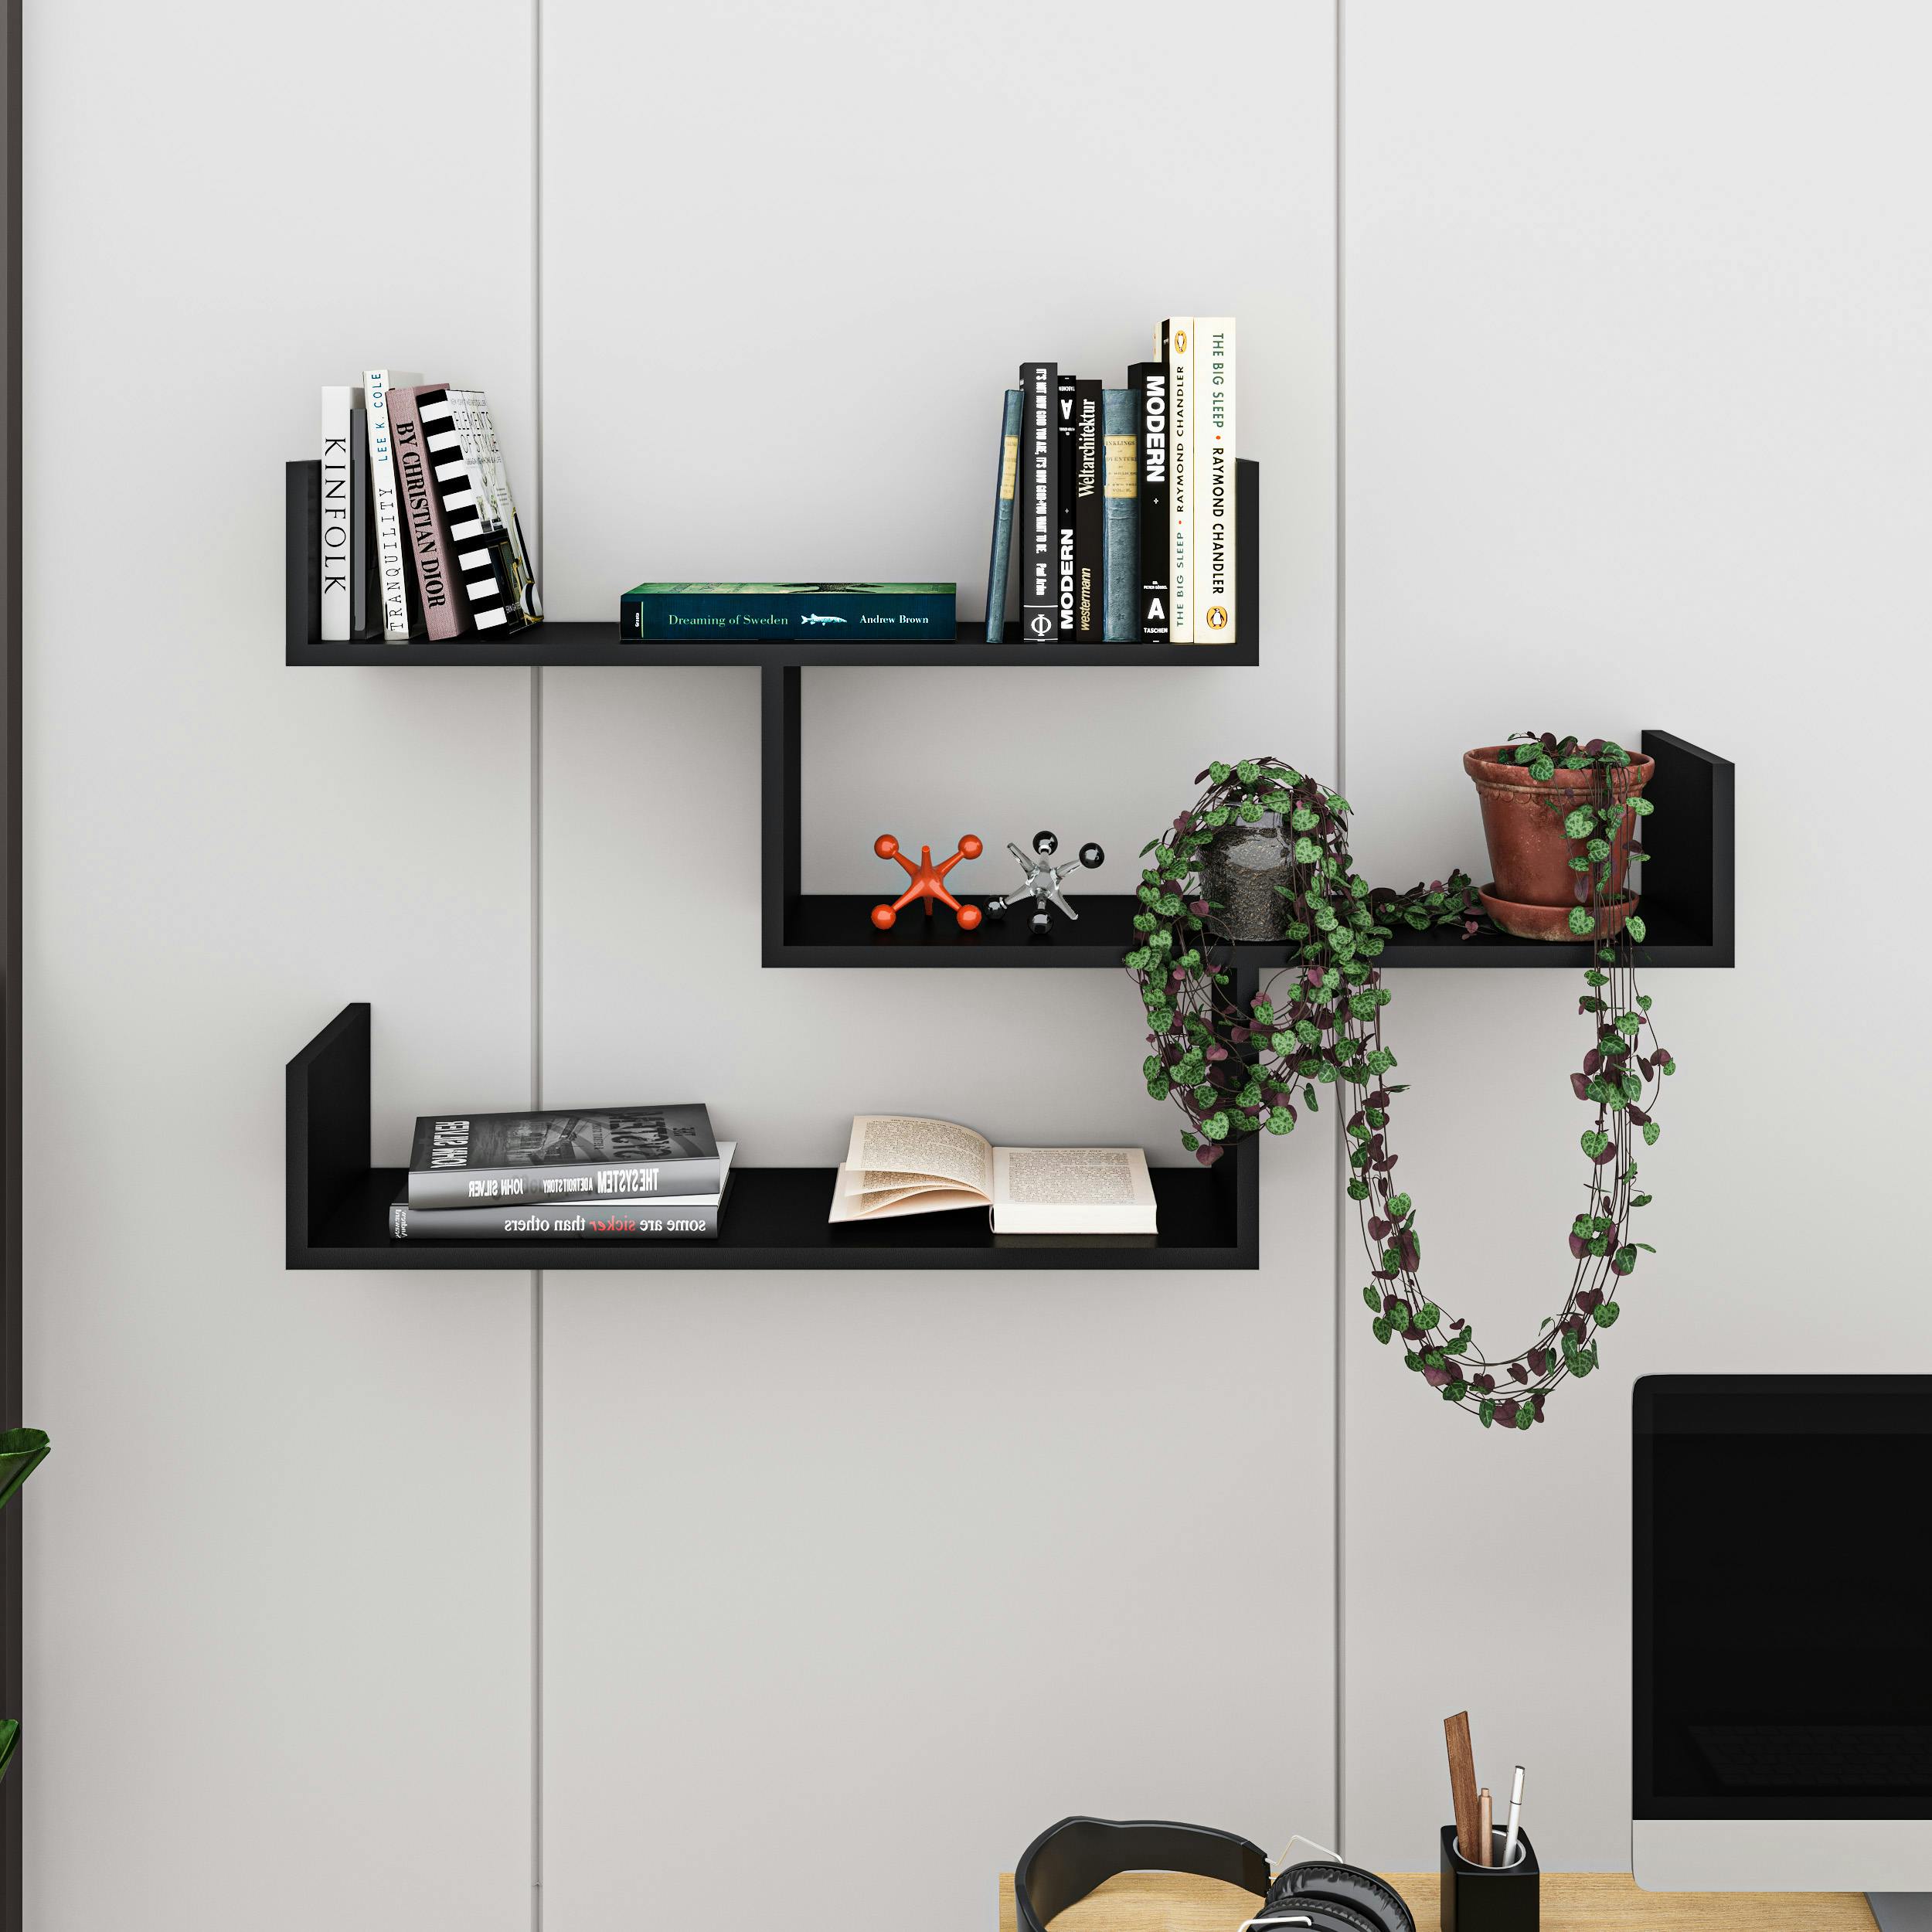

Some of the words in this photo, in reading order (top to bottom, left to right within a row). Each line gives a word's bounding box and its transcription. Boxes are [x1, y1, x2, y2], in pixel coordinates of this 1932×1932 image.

[1213, 333, 1224, 356] THE
[371, 373, 382, 408] COLE
[1213, 362, 1224, 386] BIG
[375, 416, 385, 429] K.
[1036, 410, 1047, 426] GOOD
[1060, 399, 1073, 420] A
[1213, 392, 1224, 428] SLEEP
[396, 420, 417, 447] BY
[1036, 428, 1047, 440] YOU
[1146, 376, 1165, 482] MODERN
[376, 437, 388, 461] LEE
[1078, 399, 1095, 498] Weltarchitektur
[1213, 447, 1224, 518] RAYMOND
[325, 437, 346, 594] KINFOLK
[402, 451, 437, 554] CHRISTIAN
[379, 488, 403, 631] TRANQUILITY
[1213, 522, 1224, 594] CHANDLER
[421, 558, 446, 609] DIOR
[1060, 529, 1073, 629] MODERN
[1079, 567, 1091, 631] westermann
[1147, 597, 1165, 620] A
[668, 614, 726, 628] Dreaming
[728, 614, 741, 625] of
[743, 614, 788, 625] Sweden
[859, 614, 895, 624] Andrew
[899, 615, 929, 624] Brown
